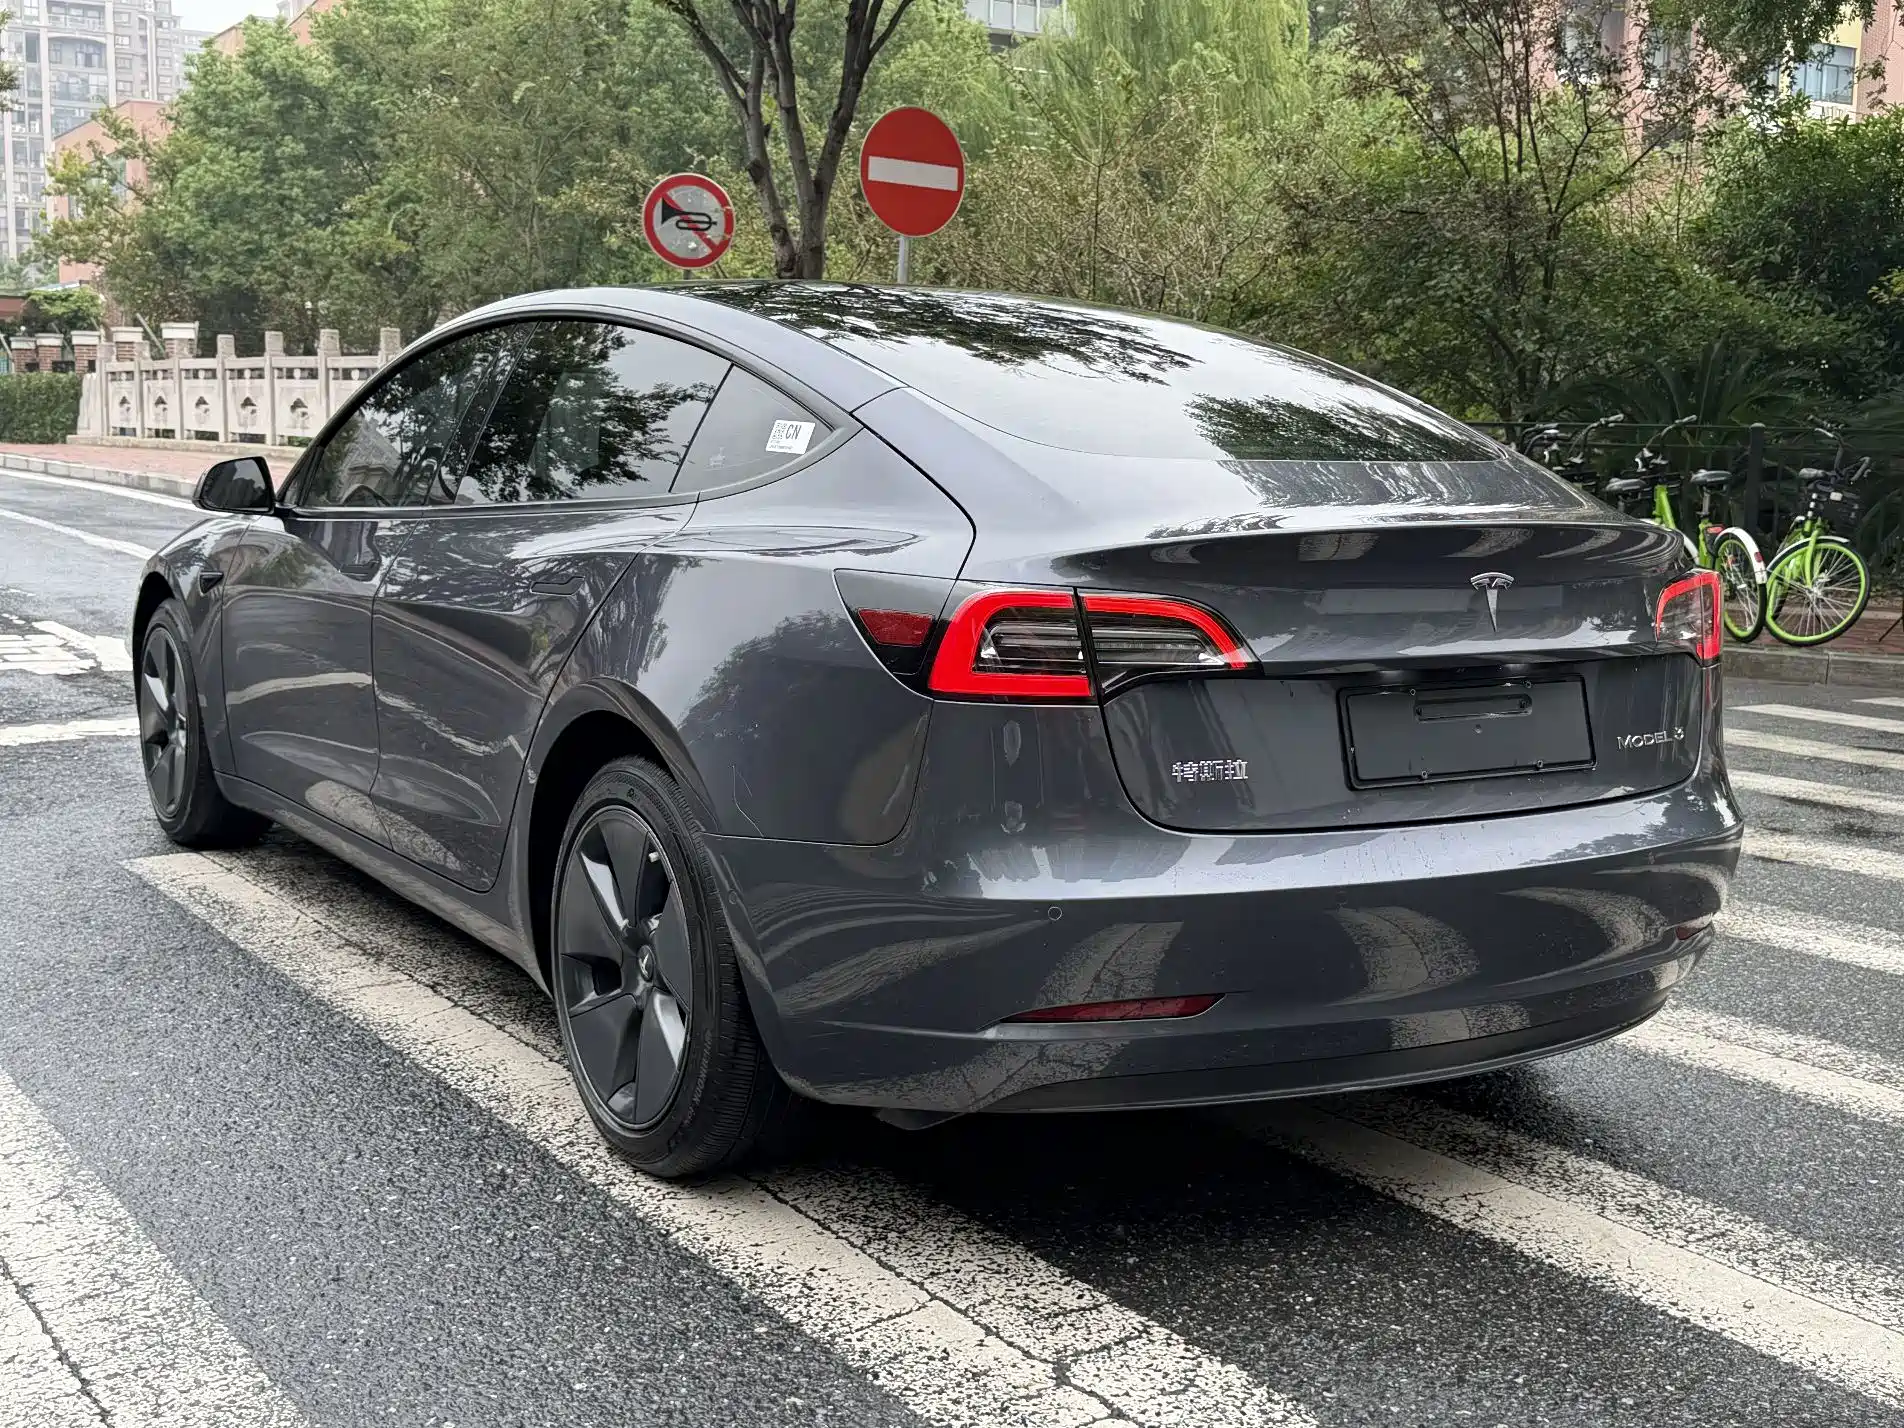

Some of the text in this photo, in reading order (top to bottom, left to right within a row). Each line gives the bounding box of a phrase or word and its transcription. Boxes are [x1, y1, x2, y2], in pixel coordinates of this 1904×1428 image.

[785, 424, 802, 440] CN
[1616, 730, 1673, 750] MODEL
[1171, 759, 1249, 783] 特斯拉
